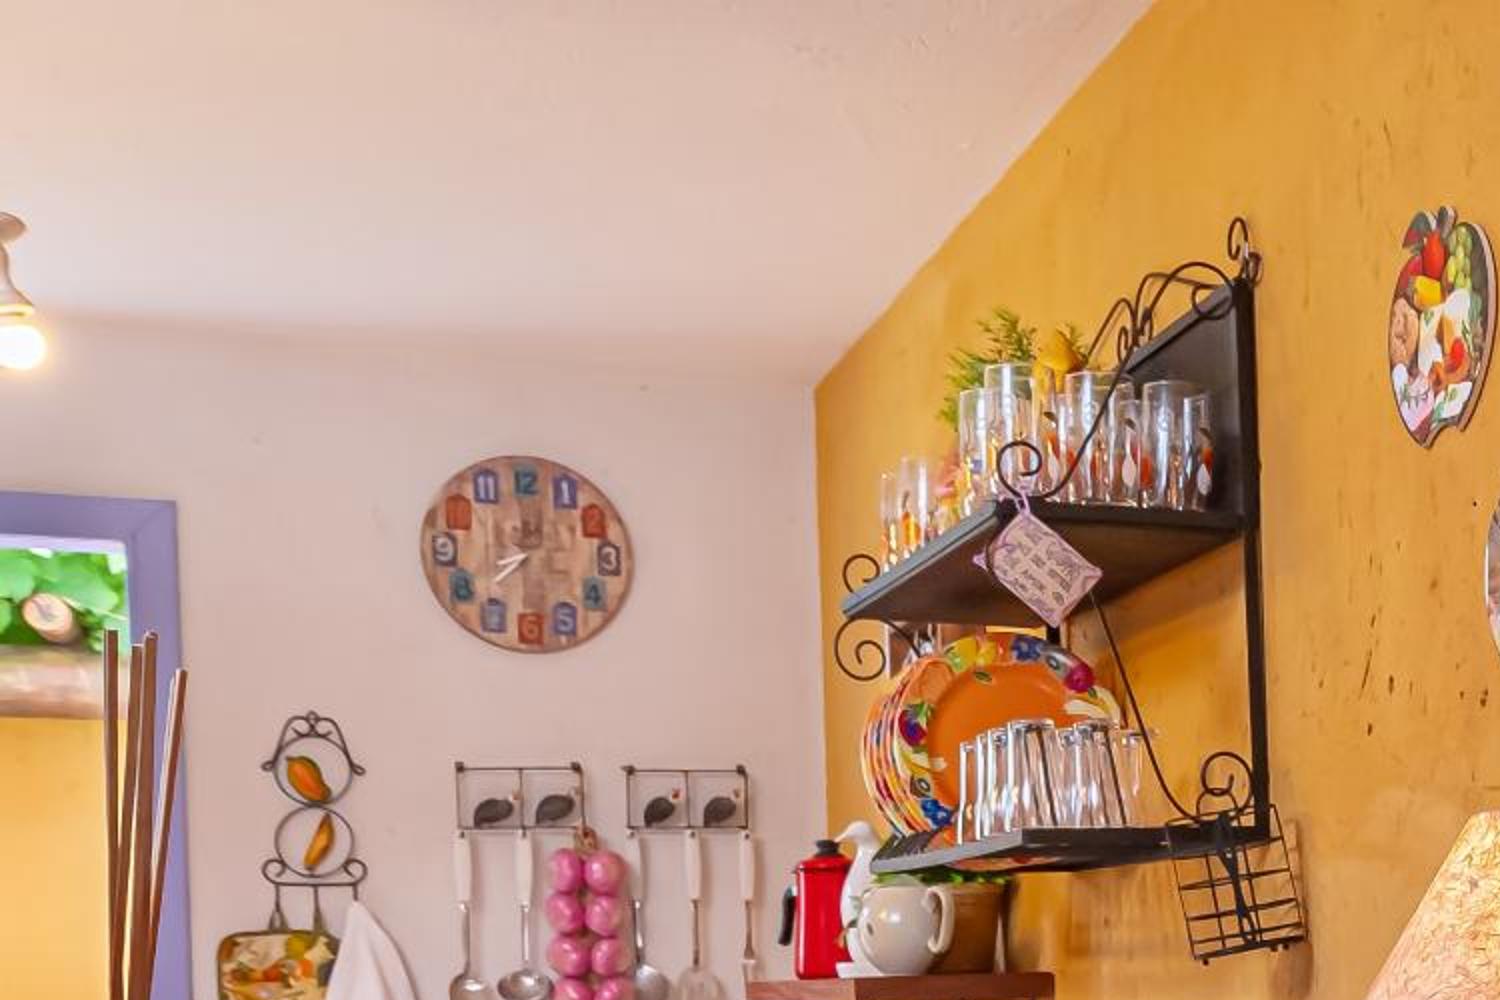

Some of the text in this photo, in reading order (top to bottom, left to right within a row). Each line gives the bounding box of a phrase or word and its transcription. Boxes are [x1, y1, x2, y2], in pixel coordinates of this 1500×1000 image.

[478, 475, 496, 500] 11
[514, 471, 539, 496] 12
[434, 536, 455, 562] 9
[601, 544, 618, 572] 3
[584, 583, 603, 606] 4
[522, 615, 540, 639] 6
[557, 607, 574, 634] 5
